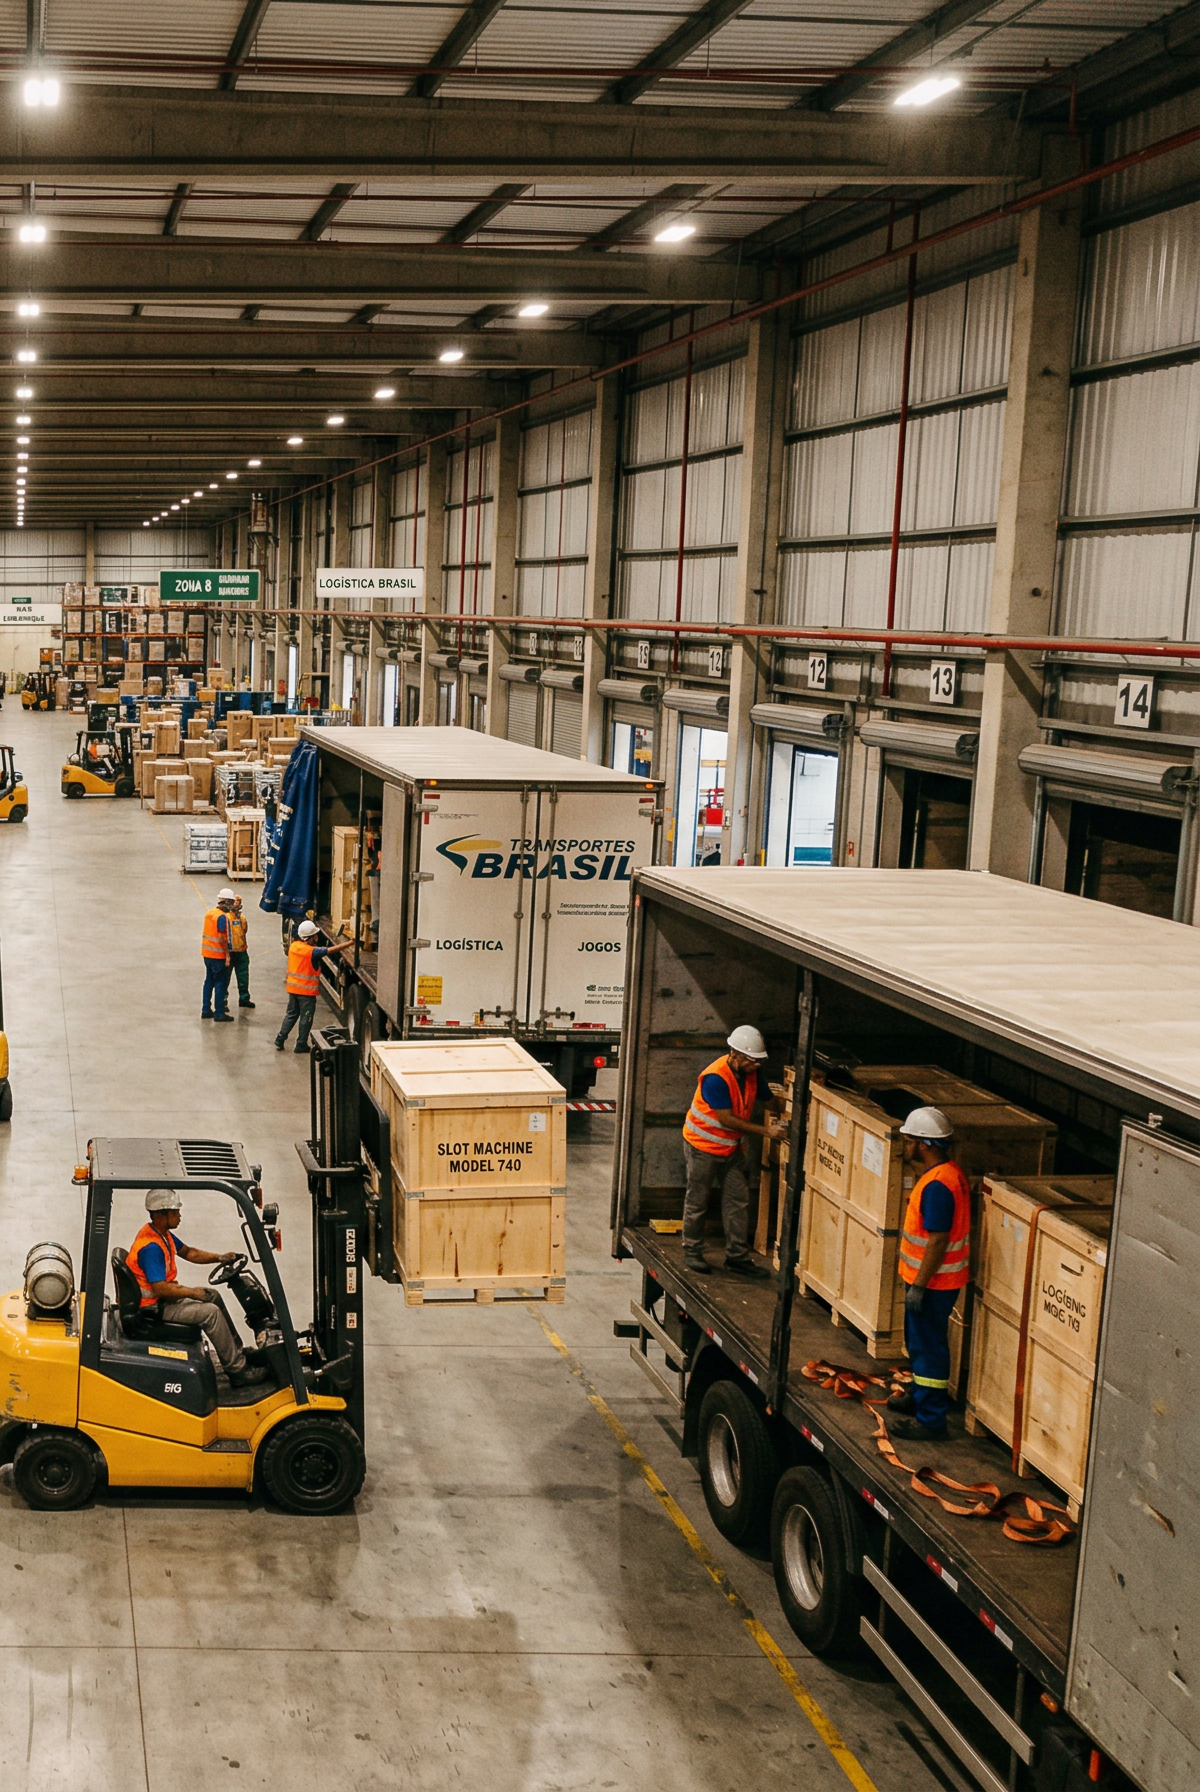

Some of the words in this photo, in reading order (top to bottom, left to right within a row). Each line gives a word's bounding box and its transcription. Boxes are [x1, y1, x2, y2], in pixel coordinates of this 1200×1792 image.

[204, 579, 212, 592] 8
[378, 578, 416, 588] BRASIL
[809, 658, 825, 684] 12
[932, 666, 953, 697] 13
[1119, 682, 1149, 719] 14
[510, 839, 636, 853] TRANSPORTES
[471, 853, 631, 880] BRASIL
[436, 937, 503, 951] LOGÍSTICA
[577, 941, 621, 952] JOGOS
[437, 1143, 470, 1156] SLOT
[473, 1141, 533, 1155] MACHINE
[449, 1159, 494, 1173] MODEL
[498, 1158, 522, 1171] 740
